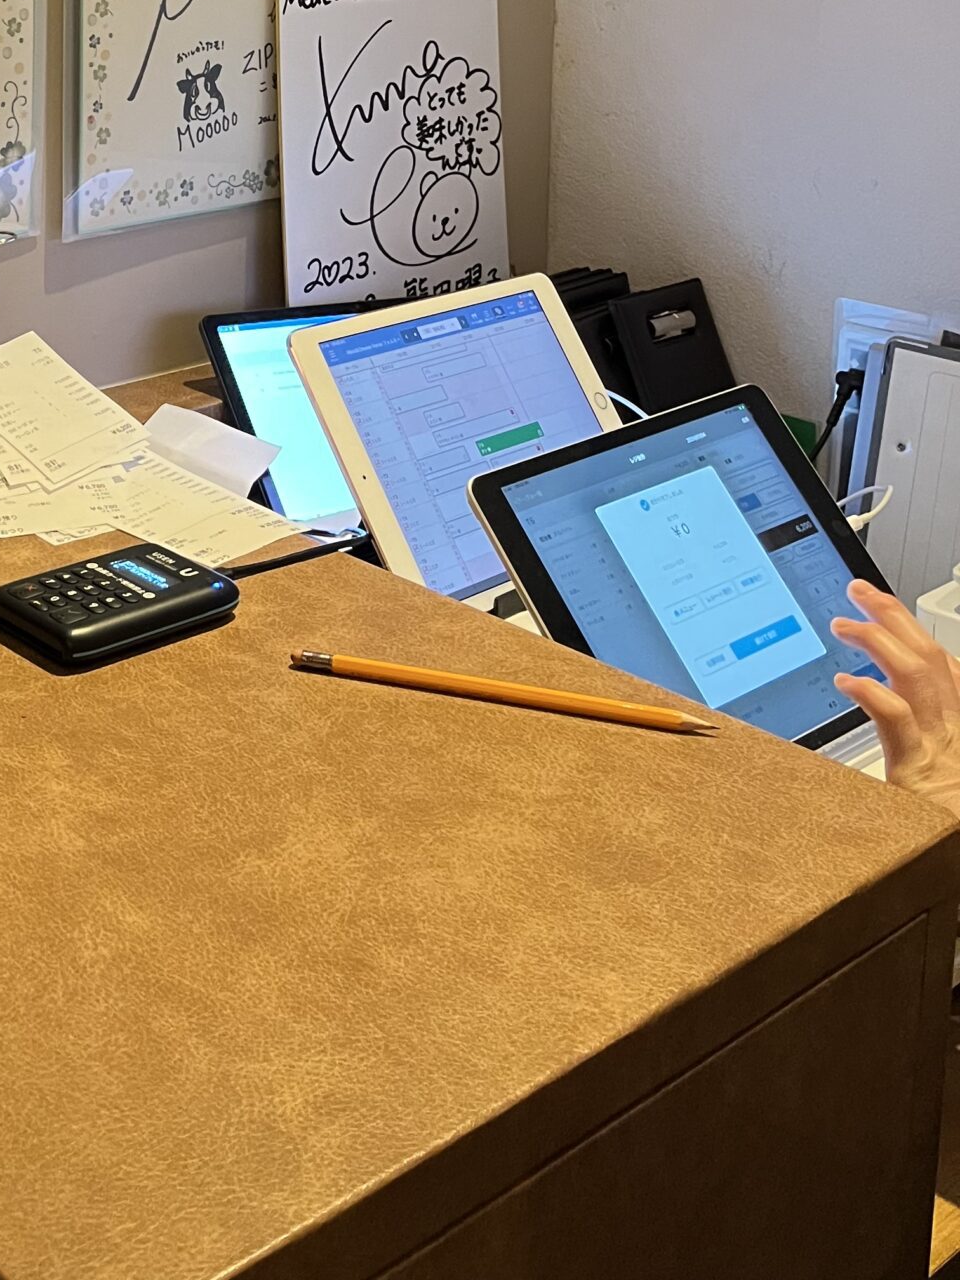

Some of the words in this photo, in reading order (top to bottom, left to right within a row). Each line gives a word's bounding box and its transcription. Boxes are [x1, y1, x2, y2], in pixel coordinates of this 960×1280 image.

[241, 42, 275, 75] ZIP
[426, 81, 467, 111] とっても
[415, 110, 490, 148] 美味しかった
